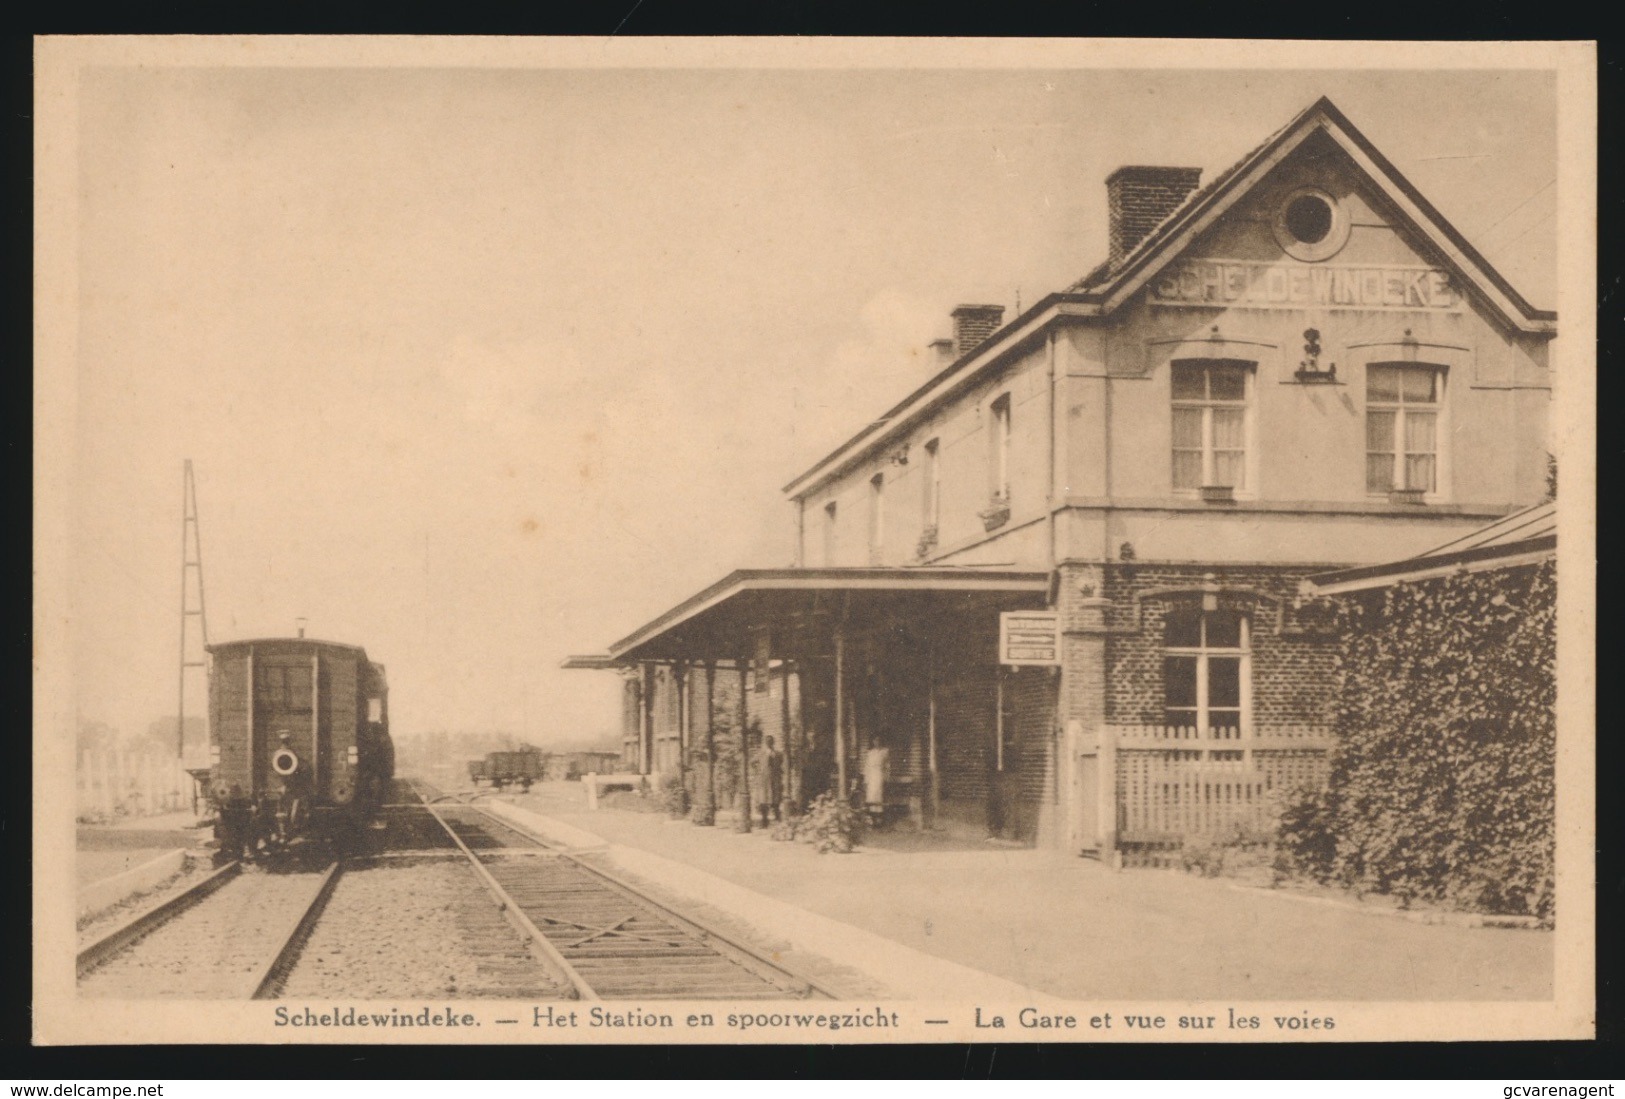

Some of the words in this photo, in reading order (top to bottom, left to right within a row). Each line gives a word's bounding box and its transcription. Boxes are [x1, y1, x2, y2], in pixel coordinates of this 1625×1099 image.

[1158, 263, 1452, 306] SCHELDEWINDEKE
[275, 1006, 482, 1028] Scheldewindeke.
[534, 1006, 578, 1028] Het
[590, 1007, 673, 1028] Station
[686, 1013, 714, 1027] en
[727, 1006, 899, 1030] spoorwegzicht
[974, 1007, 1006, 1029] La
[1018, 1007, 1077, 1029] Gare
[1090, 1012, 1112, 1029] et
[1123, 1014, 1166, 1029] vue
[1178, 1015, 1216, 1029] sur
[1228, 1007, 1261, 1029] les
[1274, 1009, 1336, 1030] voies
